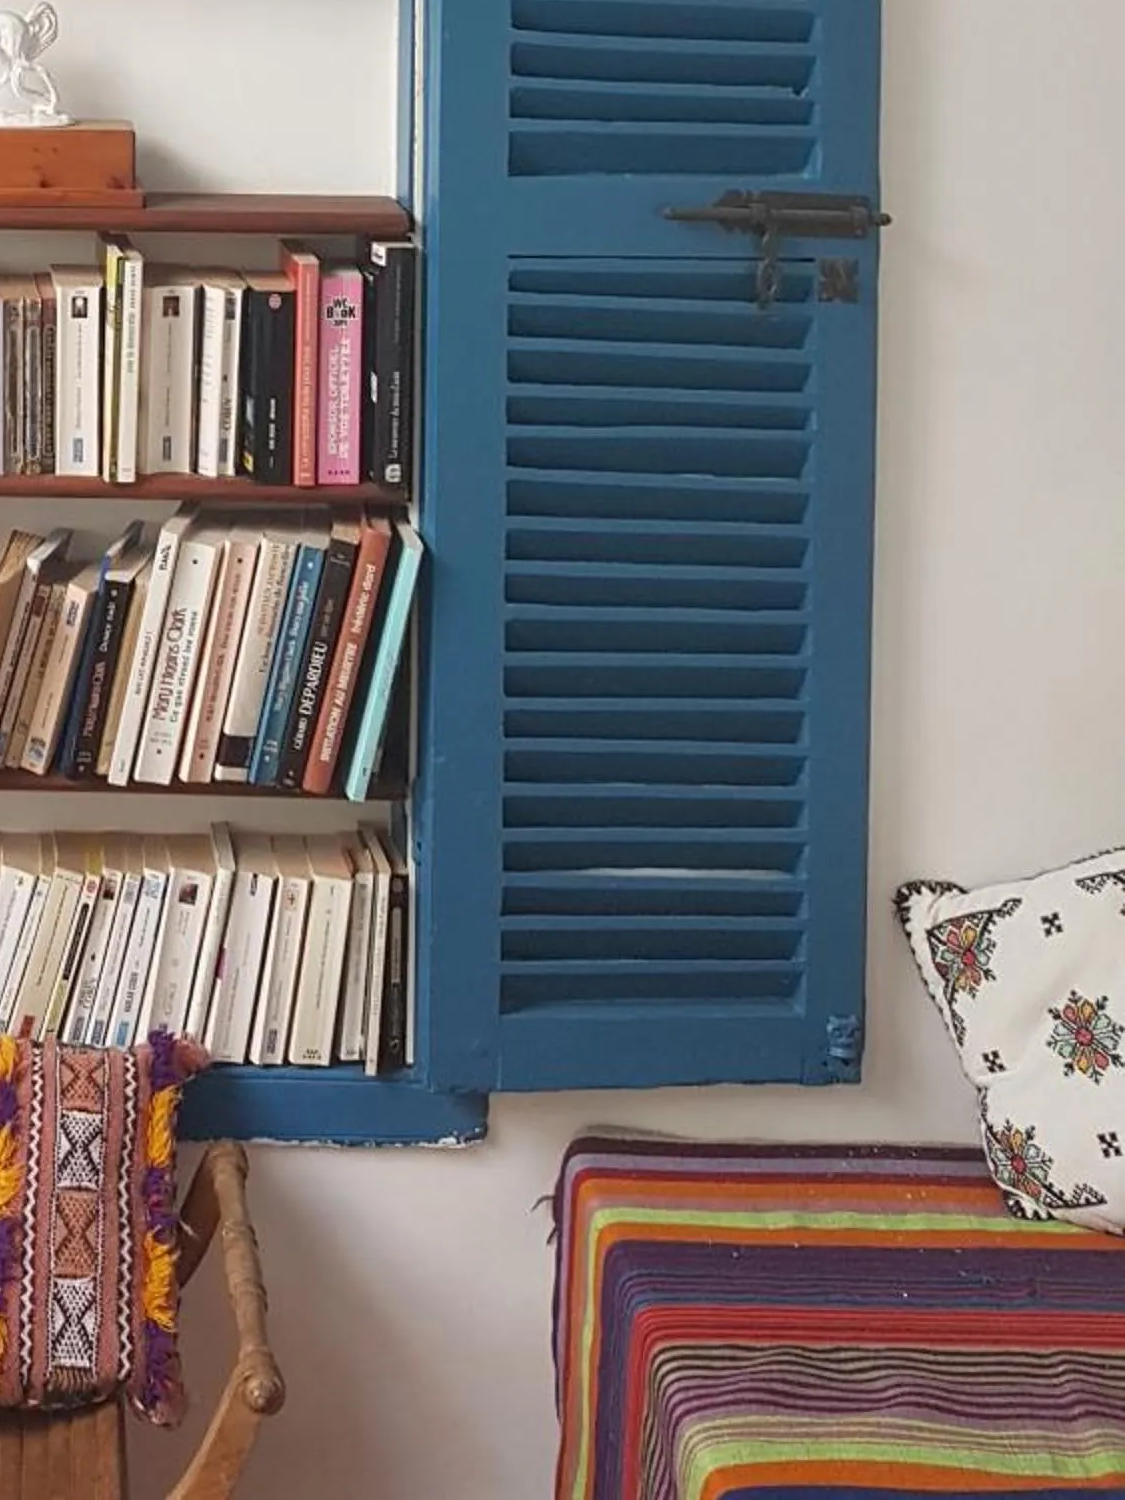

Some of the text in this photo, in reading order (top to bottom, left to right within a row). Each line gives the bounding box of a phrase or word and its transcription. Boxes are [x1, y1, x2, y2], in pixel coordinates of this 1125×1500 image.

[152, 605, 186, 721] Mary Higgins Clark
[297, 640, 328, 715] DEPARDIEU
[332, 688, 346, 706] AU
